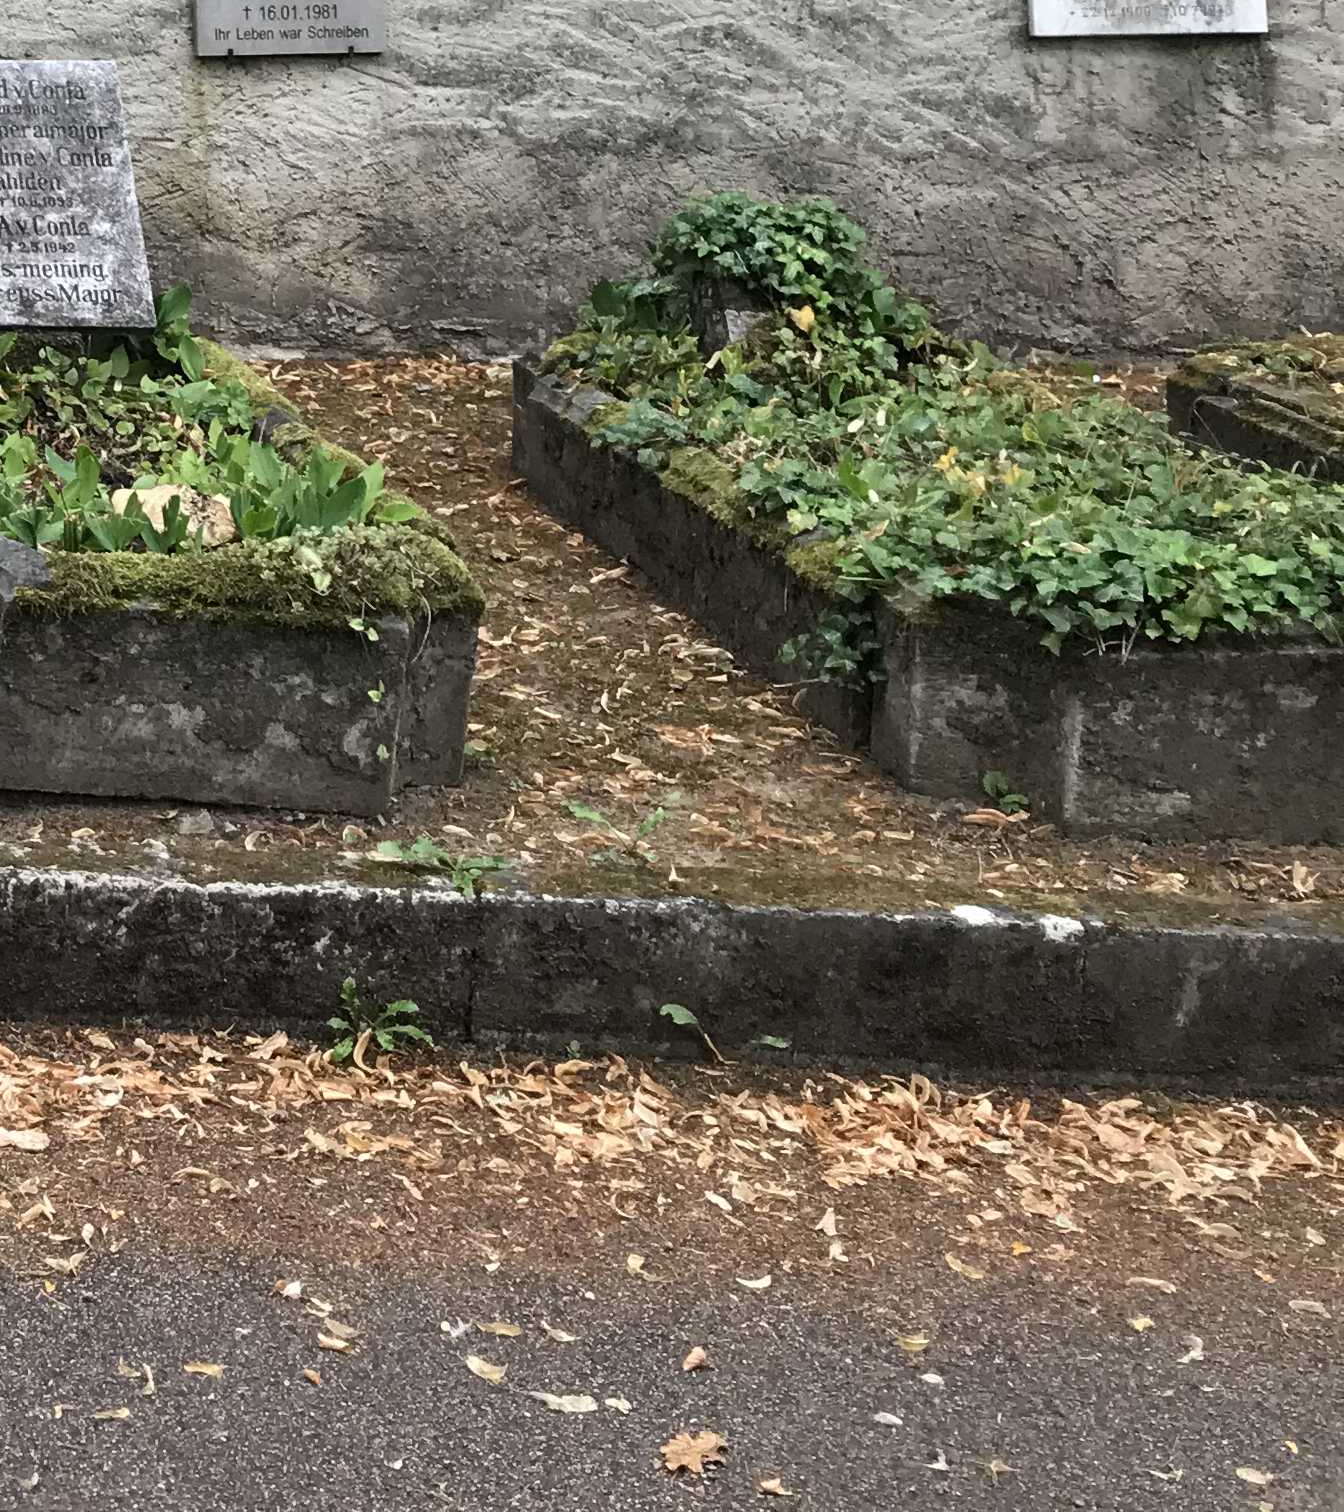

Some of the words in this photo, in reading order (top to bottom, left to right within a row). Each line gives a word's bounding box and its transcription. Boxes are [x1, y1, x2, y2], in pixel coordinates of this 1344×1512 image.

[259, 4, 339, 21] 16.01.1981
[214, 28, 231, 41] Ihr
[235, 26, 275, 41] Leben
[278, 28, 303, 40] war
[306, 25, 369, 39] Schreiben
[28, 78, 87, 102] Conta
[56, 146, 113, 168] Conta
[32, 214, 92, 237] Conta
